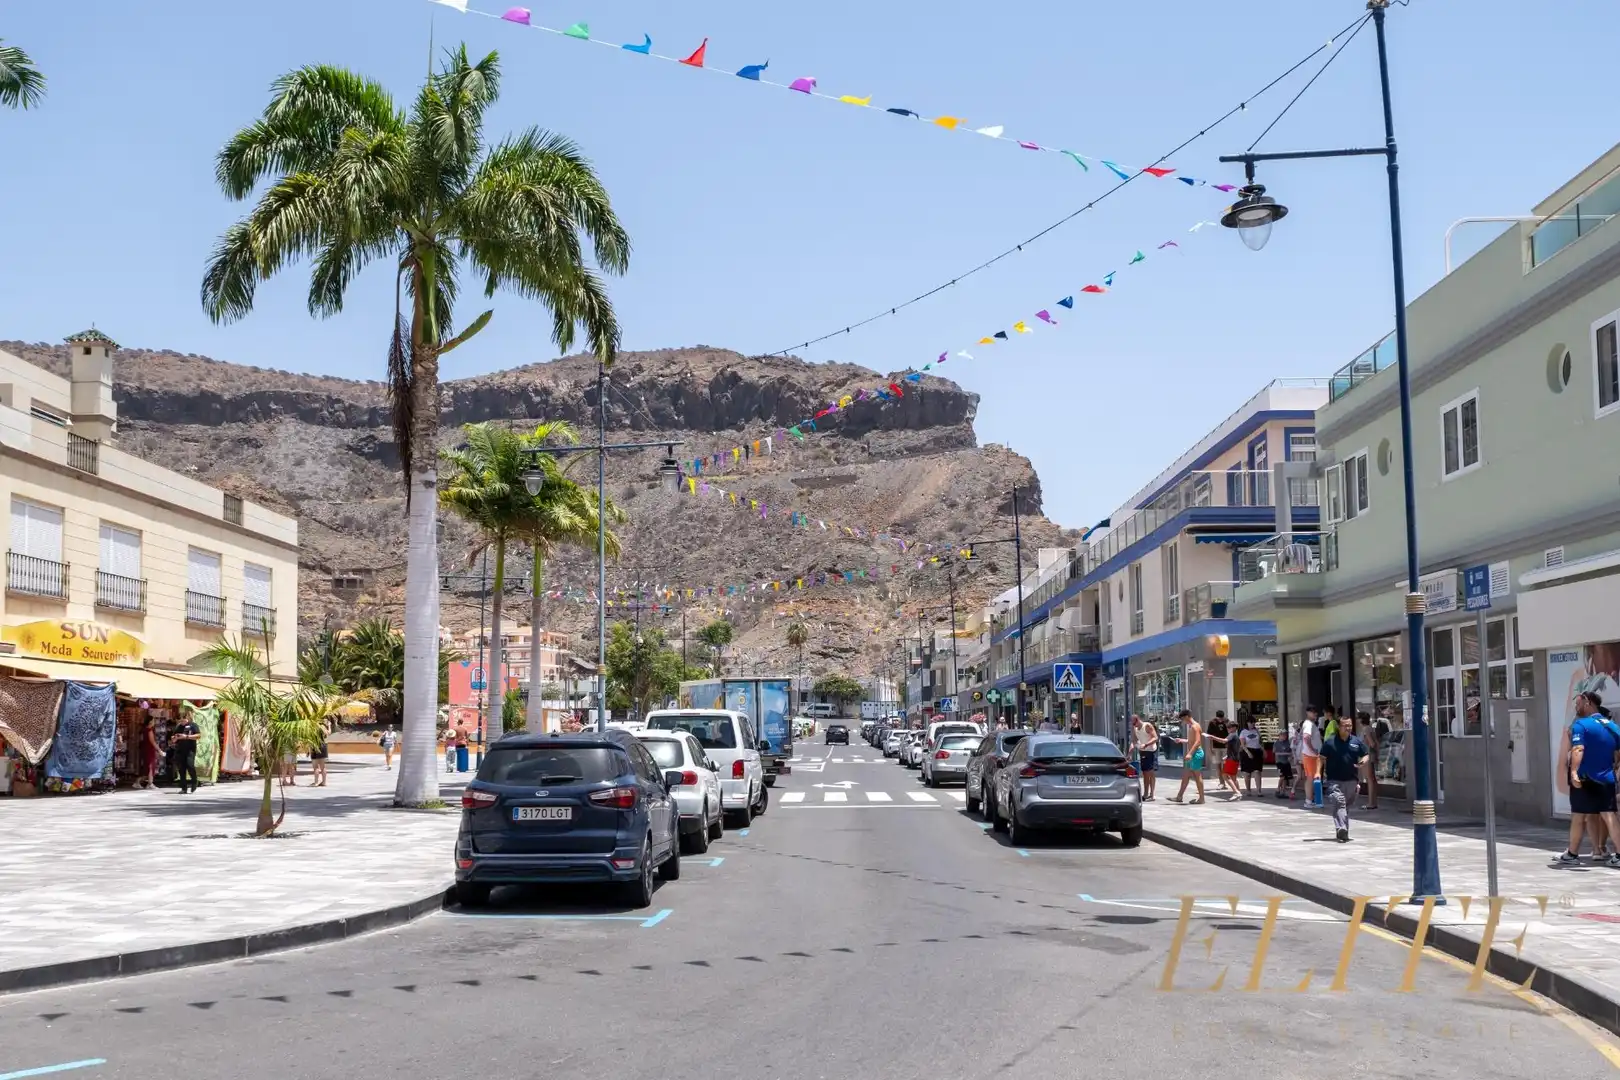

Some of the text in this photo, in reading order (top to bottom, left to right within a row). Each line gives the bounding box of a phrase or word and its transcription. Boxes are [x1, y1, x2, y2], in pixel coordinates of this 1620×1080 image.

[60, 622, 109, 644] SUN
[40, 641, 128, 661] Moda Souvenirs
[521, 808, 570, 819] 3170 LGT
